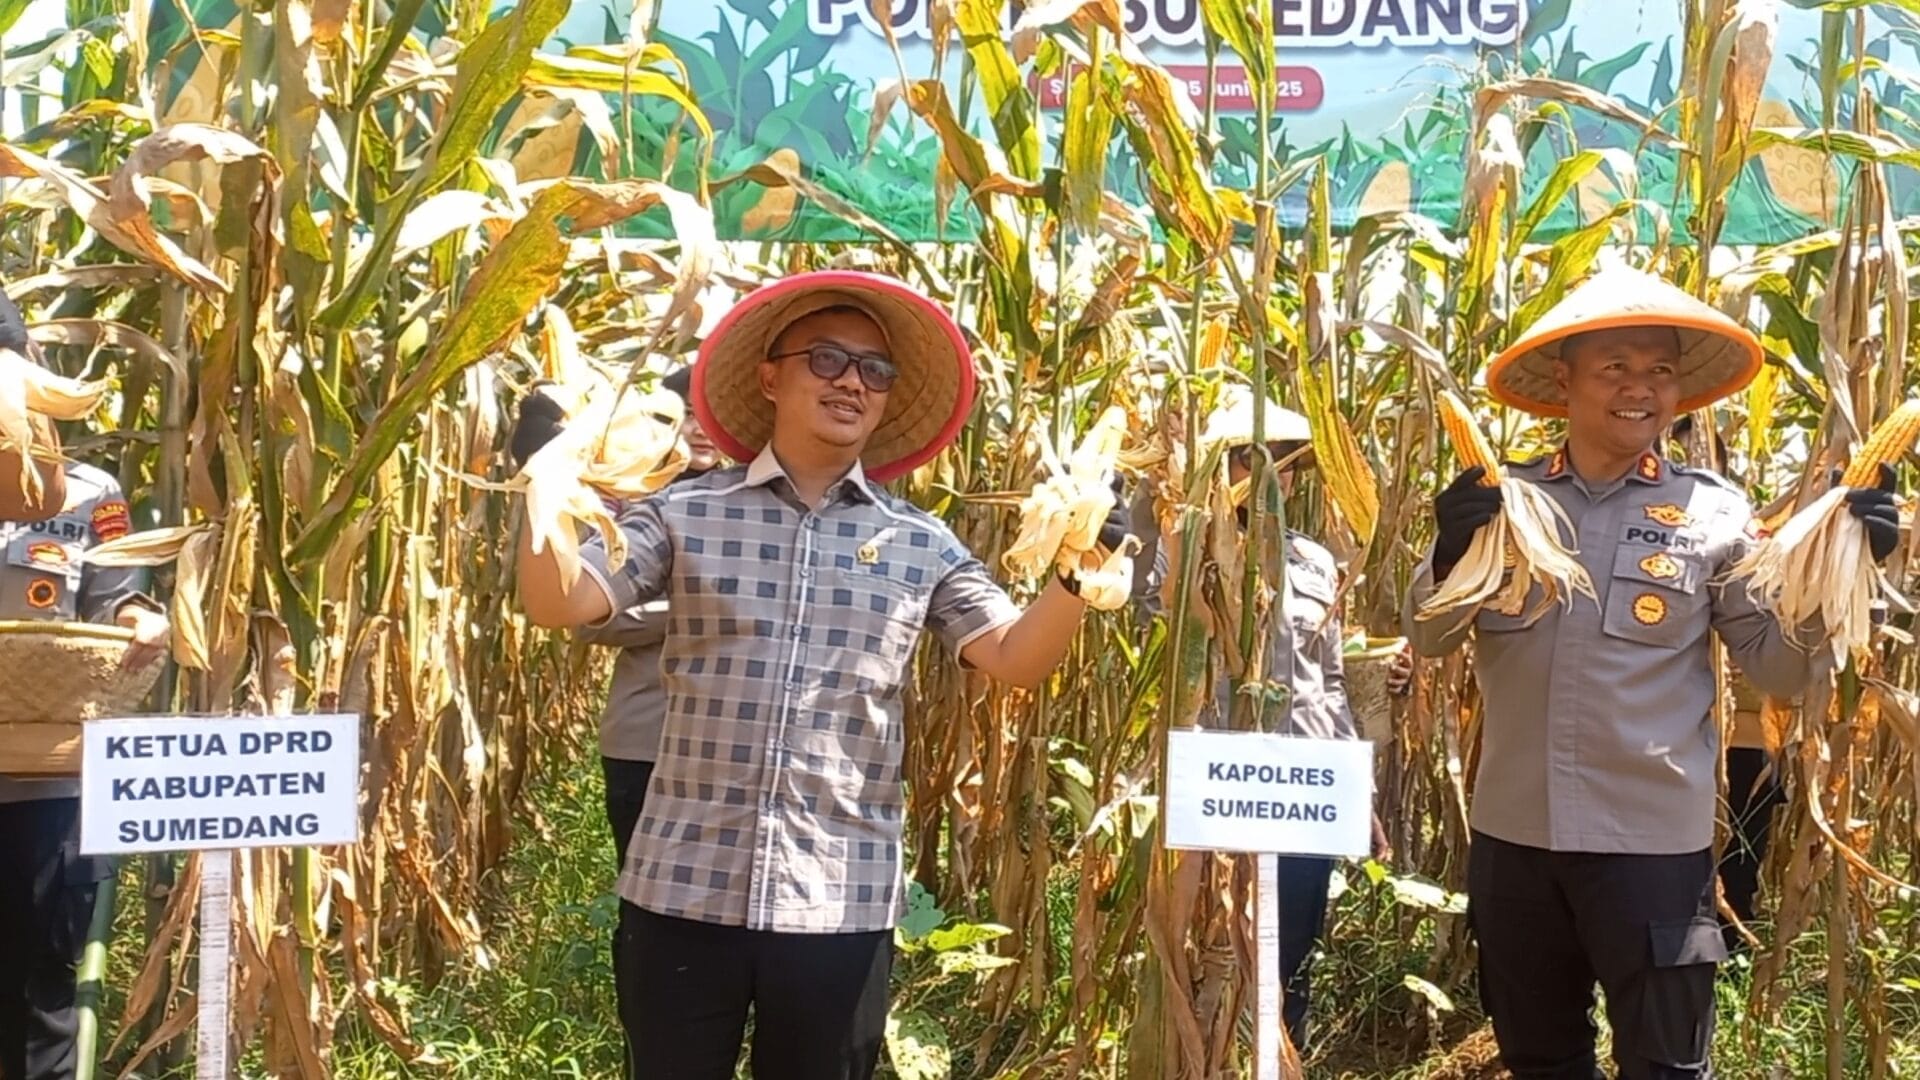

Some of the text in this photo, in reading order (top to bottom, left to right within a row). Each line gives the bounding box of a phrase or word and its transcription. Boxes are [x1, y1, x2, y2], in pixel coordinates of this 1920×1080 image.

[16, 520, 84, 541] OLRI
[106, 730, 333, 759] KETUA DPRD
[112, 771, 325, 801] KABUPATEN
[1208, 762, 1335, 787] KAPOLRES
[1202, 798, 1337, 823] SUMEDANG
[118, 813, 319, 844] SUMEDANG
